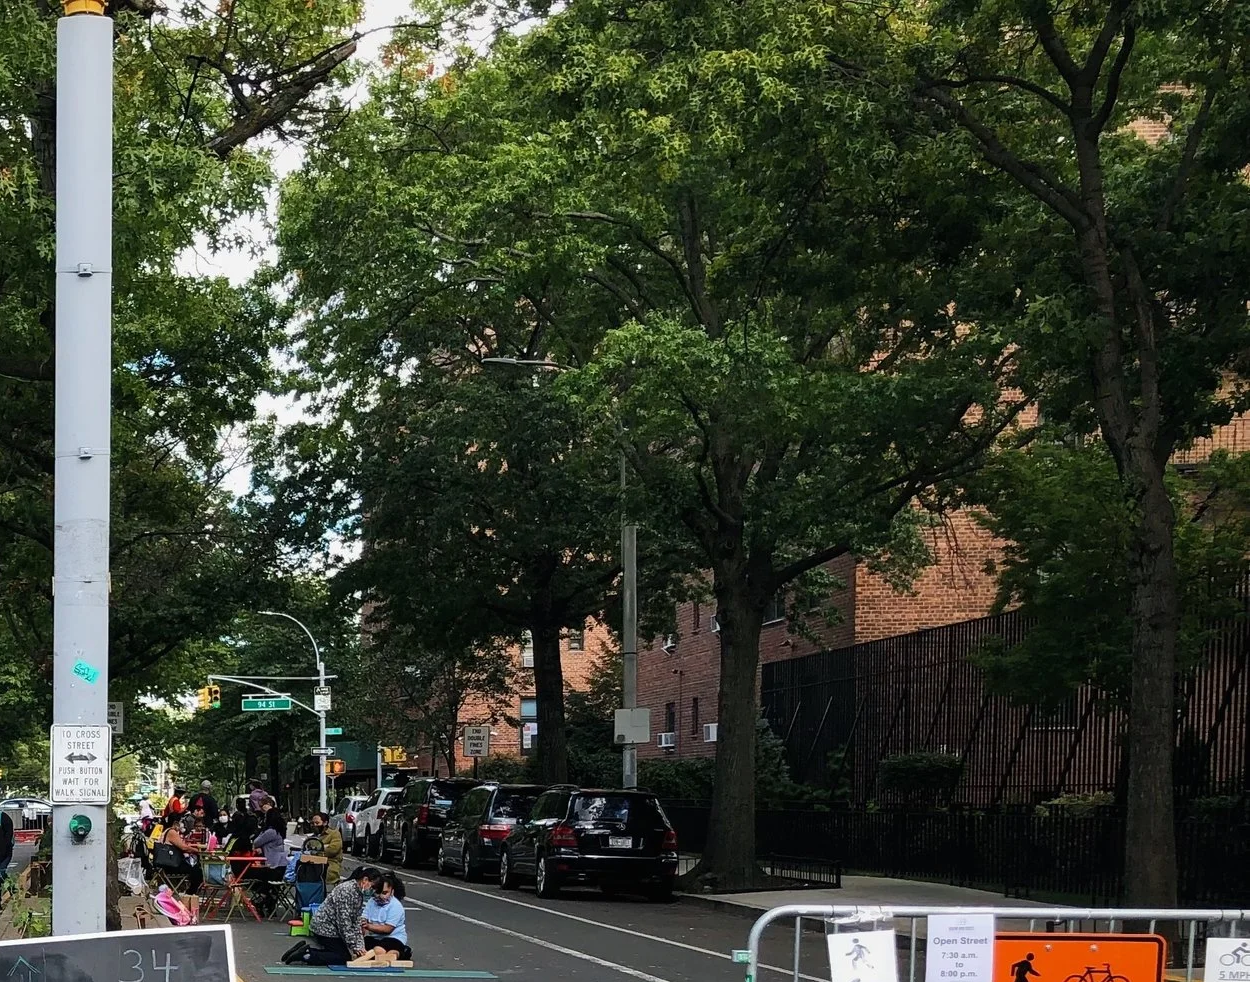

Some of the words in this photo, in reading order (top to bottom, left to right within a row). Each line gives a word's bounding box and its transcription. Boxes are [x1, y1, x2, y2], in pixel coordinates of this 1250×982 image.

[62, 730, 72, 739] TO
[75, 730, 101, 739] CROSS
[67, 741, 95, 750] STREET
[58, 766, 76, 775] PUSH
[79, 766, 103, 775] BUTTON
[62, 777, 79, 786] WAIT
[84, 777, 99, 786] FOR
[54, 788, 76, 797] WALK
[79, 788, 106, 797] SIGNAL
[933, 936, 958, 947] Open
[960, 936, 988, 945] Street
[941, 951, 959, 959] 7:30
[960, 951, 979, 959] a.m.
[960, 970, 978, 979] p.m.
[1219, 970, 1226, 979] 5
